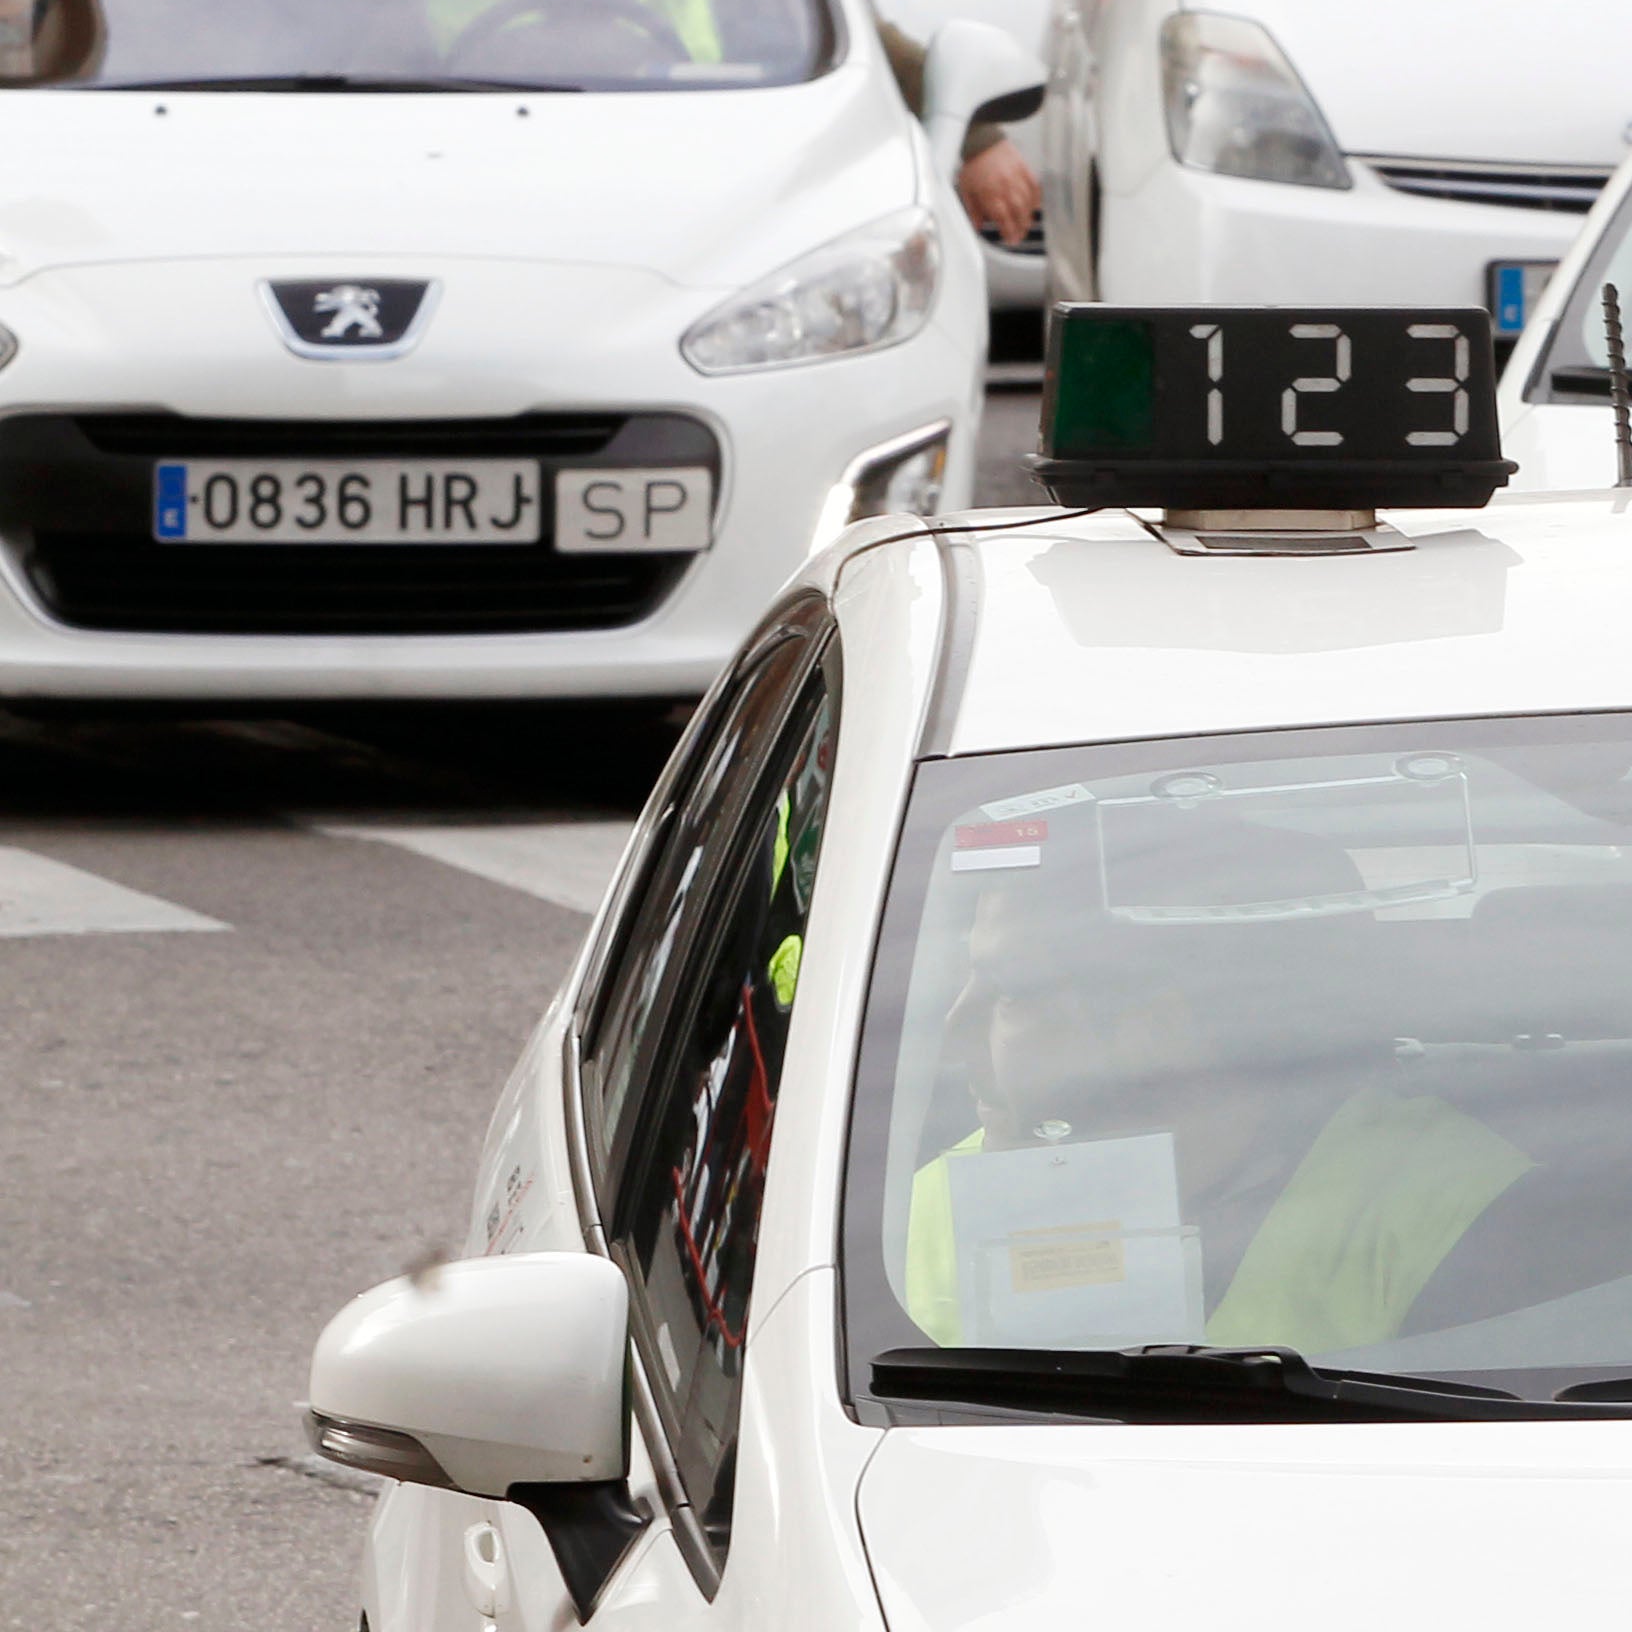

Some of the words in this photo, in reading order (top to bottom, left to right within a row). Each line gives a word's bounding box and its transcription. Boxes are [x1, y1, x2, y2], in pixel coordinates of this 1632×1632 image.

[1189, 324, 1470, 446] 123
[203, 473, 372, 530] 0836
[399, 472, 530, 530] HRJ
[582, 480, 688, 540] SP
